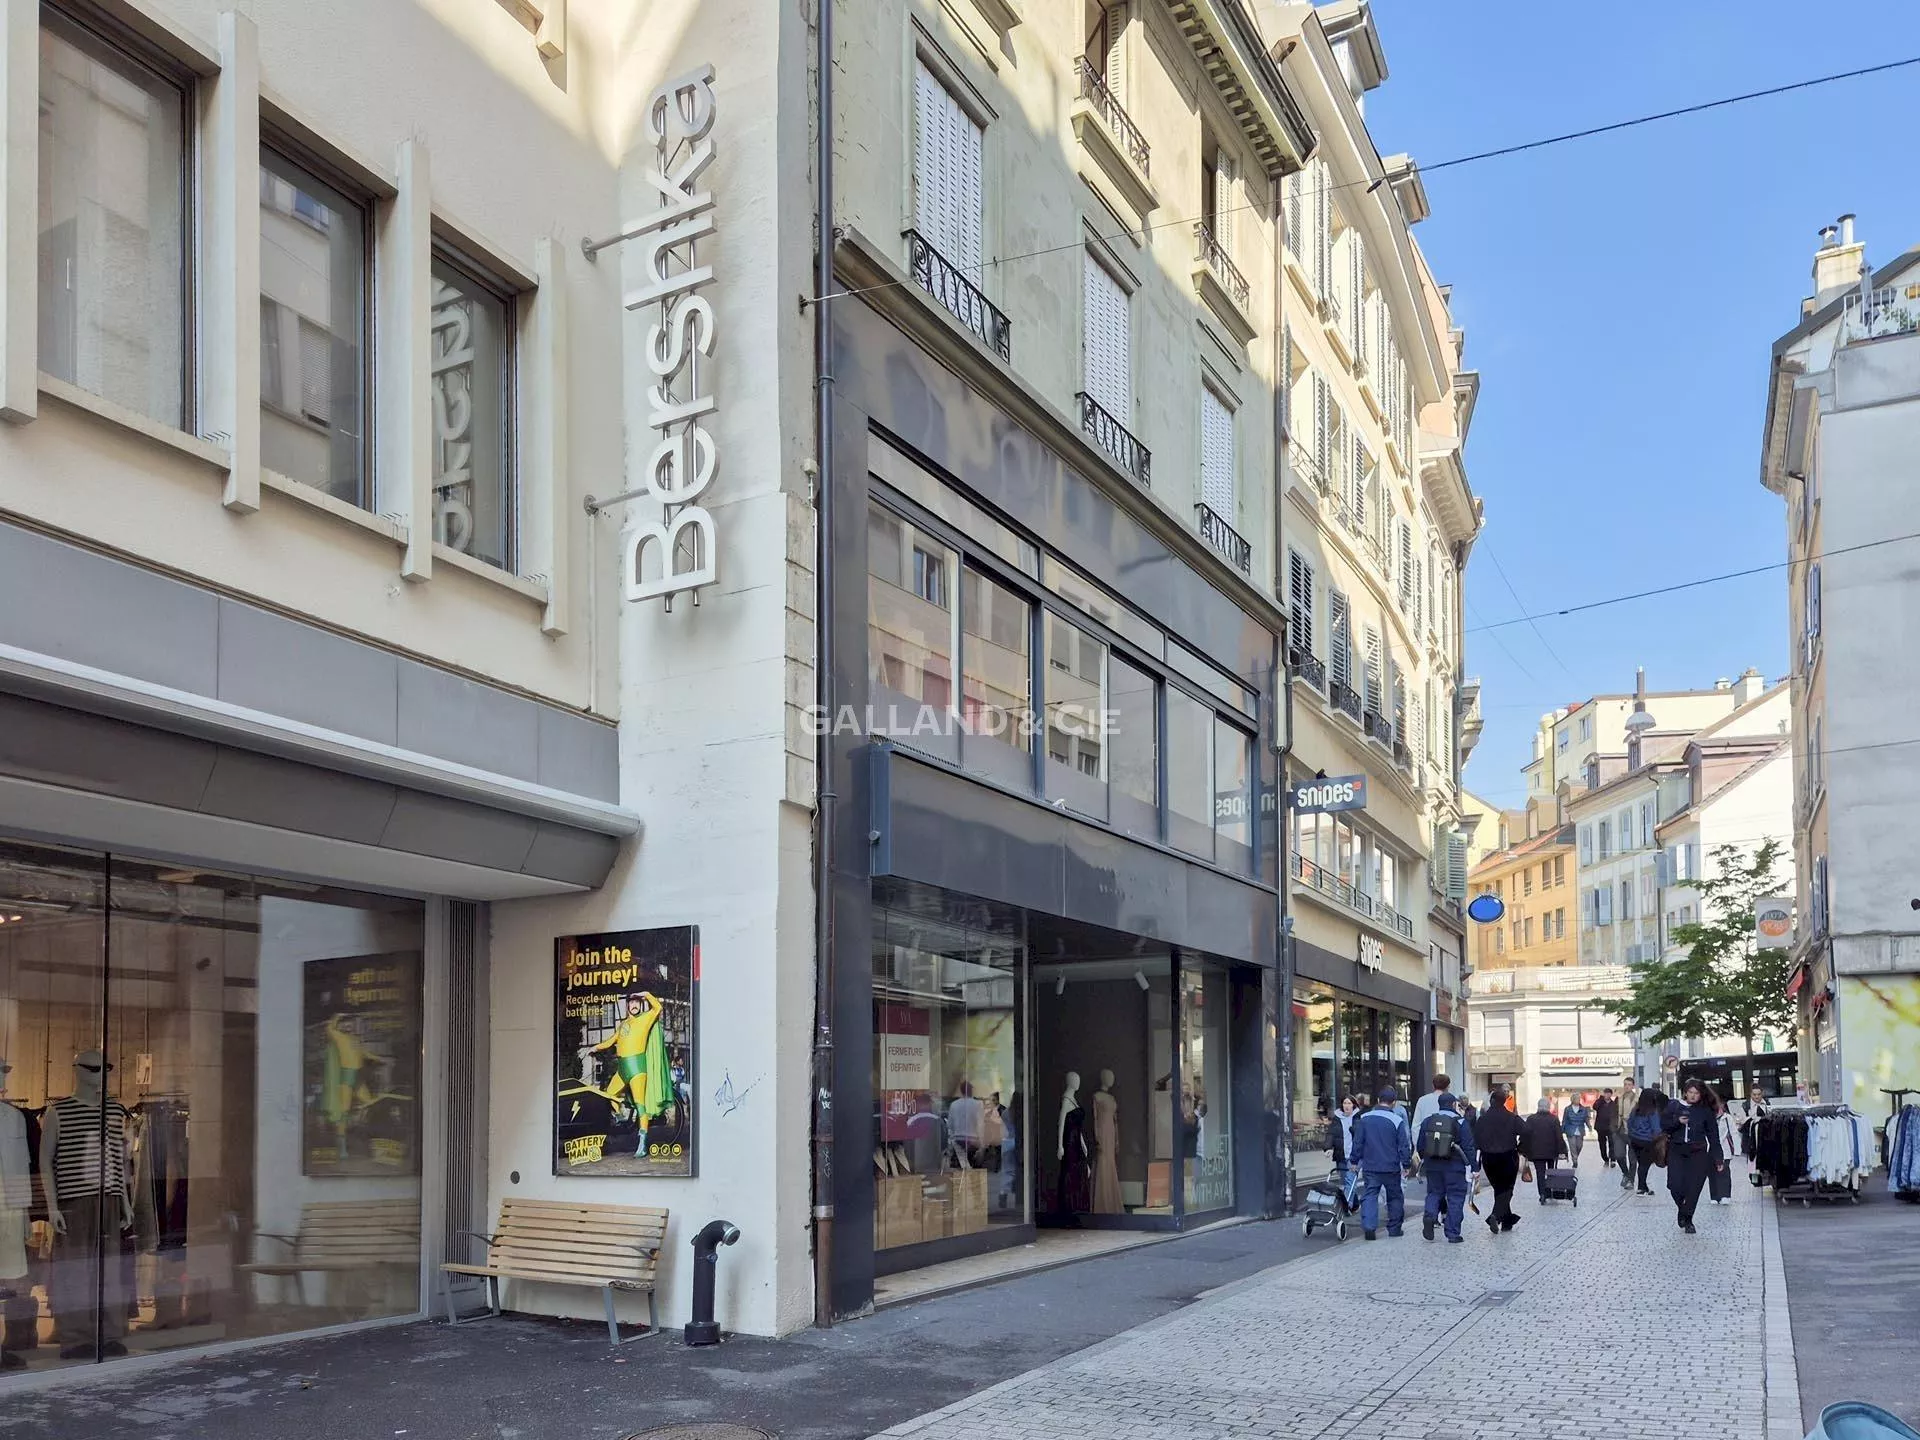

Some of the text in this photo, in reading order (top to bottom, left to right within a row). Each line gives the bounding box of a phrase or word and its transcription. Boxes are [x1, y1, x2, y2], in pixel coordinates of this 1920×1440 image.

[625, 62, 720, 602] Bershka
[1297, 780, 1354, 809] snipes
[566, 945, 632, 967] Join the
[566, 964, 638, 991] journey!
[566, 993, 621, 1006] Recycle your
[565, 1006, 607, 1018] batteries.
[888, 1046, 924, 1057] FERMETURE
[565, 1136, 605, 1152] BATTERY
[569, 1148, 589, 1160] MAN
[1201, 1155, 1229, 1176] READY
